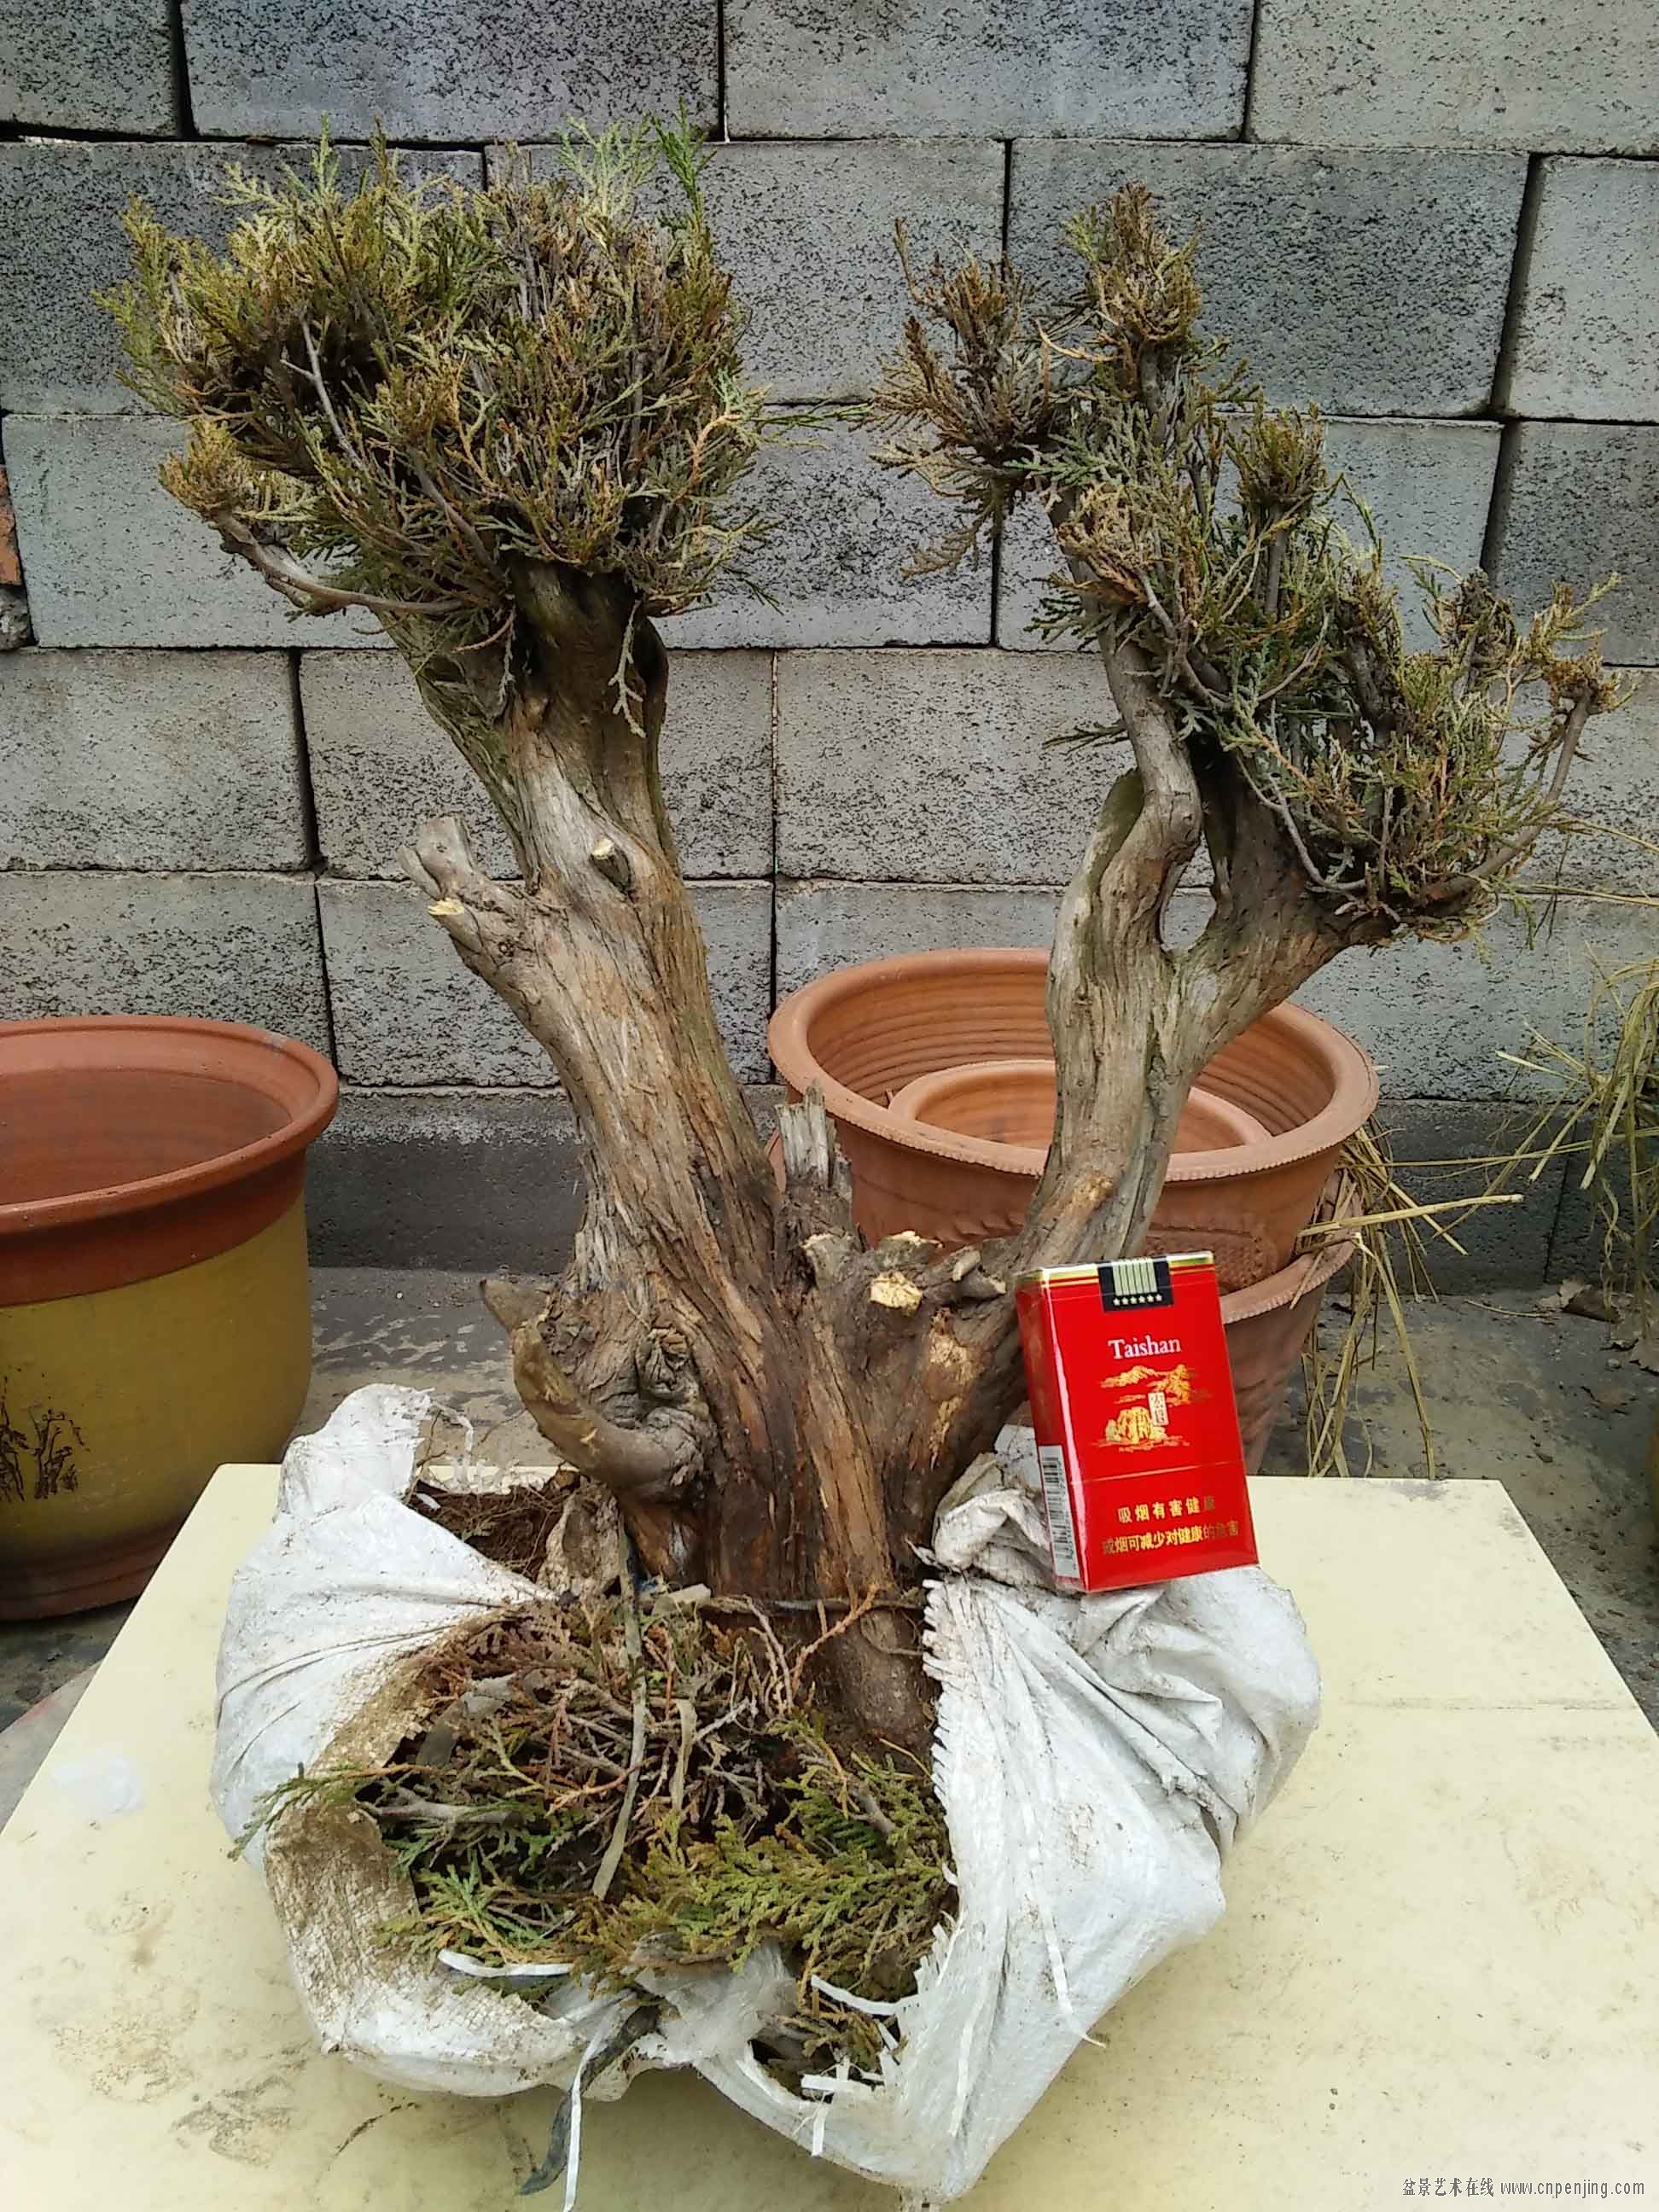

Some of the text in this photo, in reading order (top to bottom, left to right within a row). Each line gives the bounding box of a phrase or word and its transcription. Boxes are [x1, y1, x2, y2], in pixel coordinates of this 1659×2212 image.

[1108, 1335, 1181, 1359] Taishan
[1118, 1496, 1215, 1523] 吸烟有害健康
